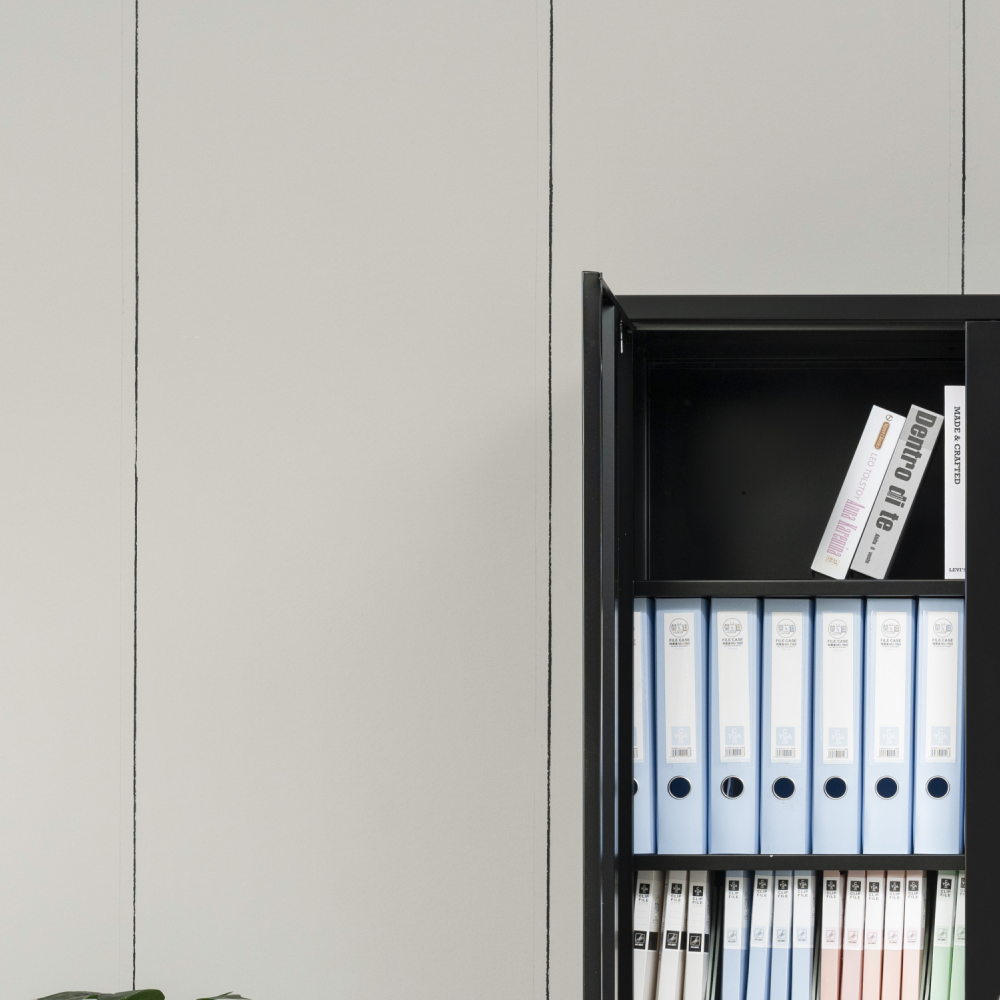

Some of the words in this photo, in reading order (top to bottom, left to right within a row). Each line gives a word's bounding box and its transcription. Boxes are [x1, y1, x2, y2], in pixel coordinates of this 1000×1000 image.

[894, 410, 937, 482] Dentro
[867, 452, 878, 467] LEO
[854, 469, 872, 500] TOLSTOY
[884, 484, 907, 508] di
[841, 498, 865, 521] Anna
[876, 510, 899, 532] te
[826, 519, 858, 557] Karenina
